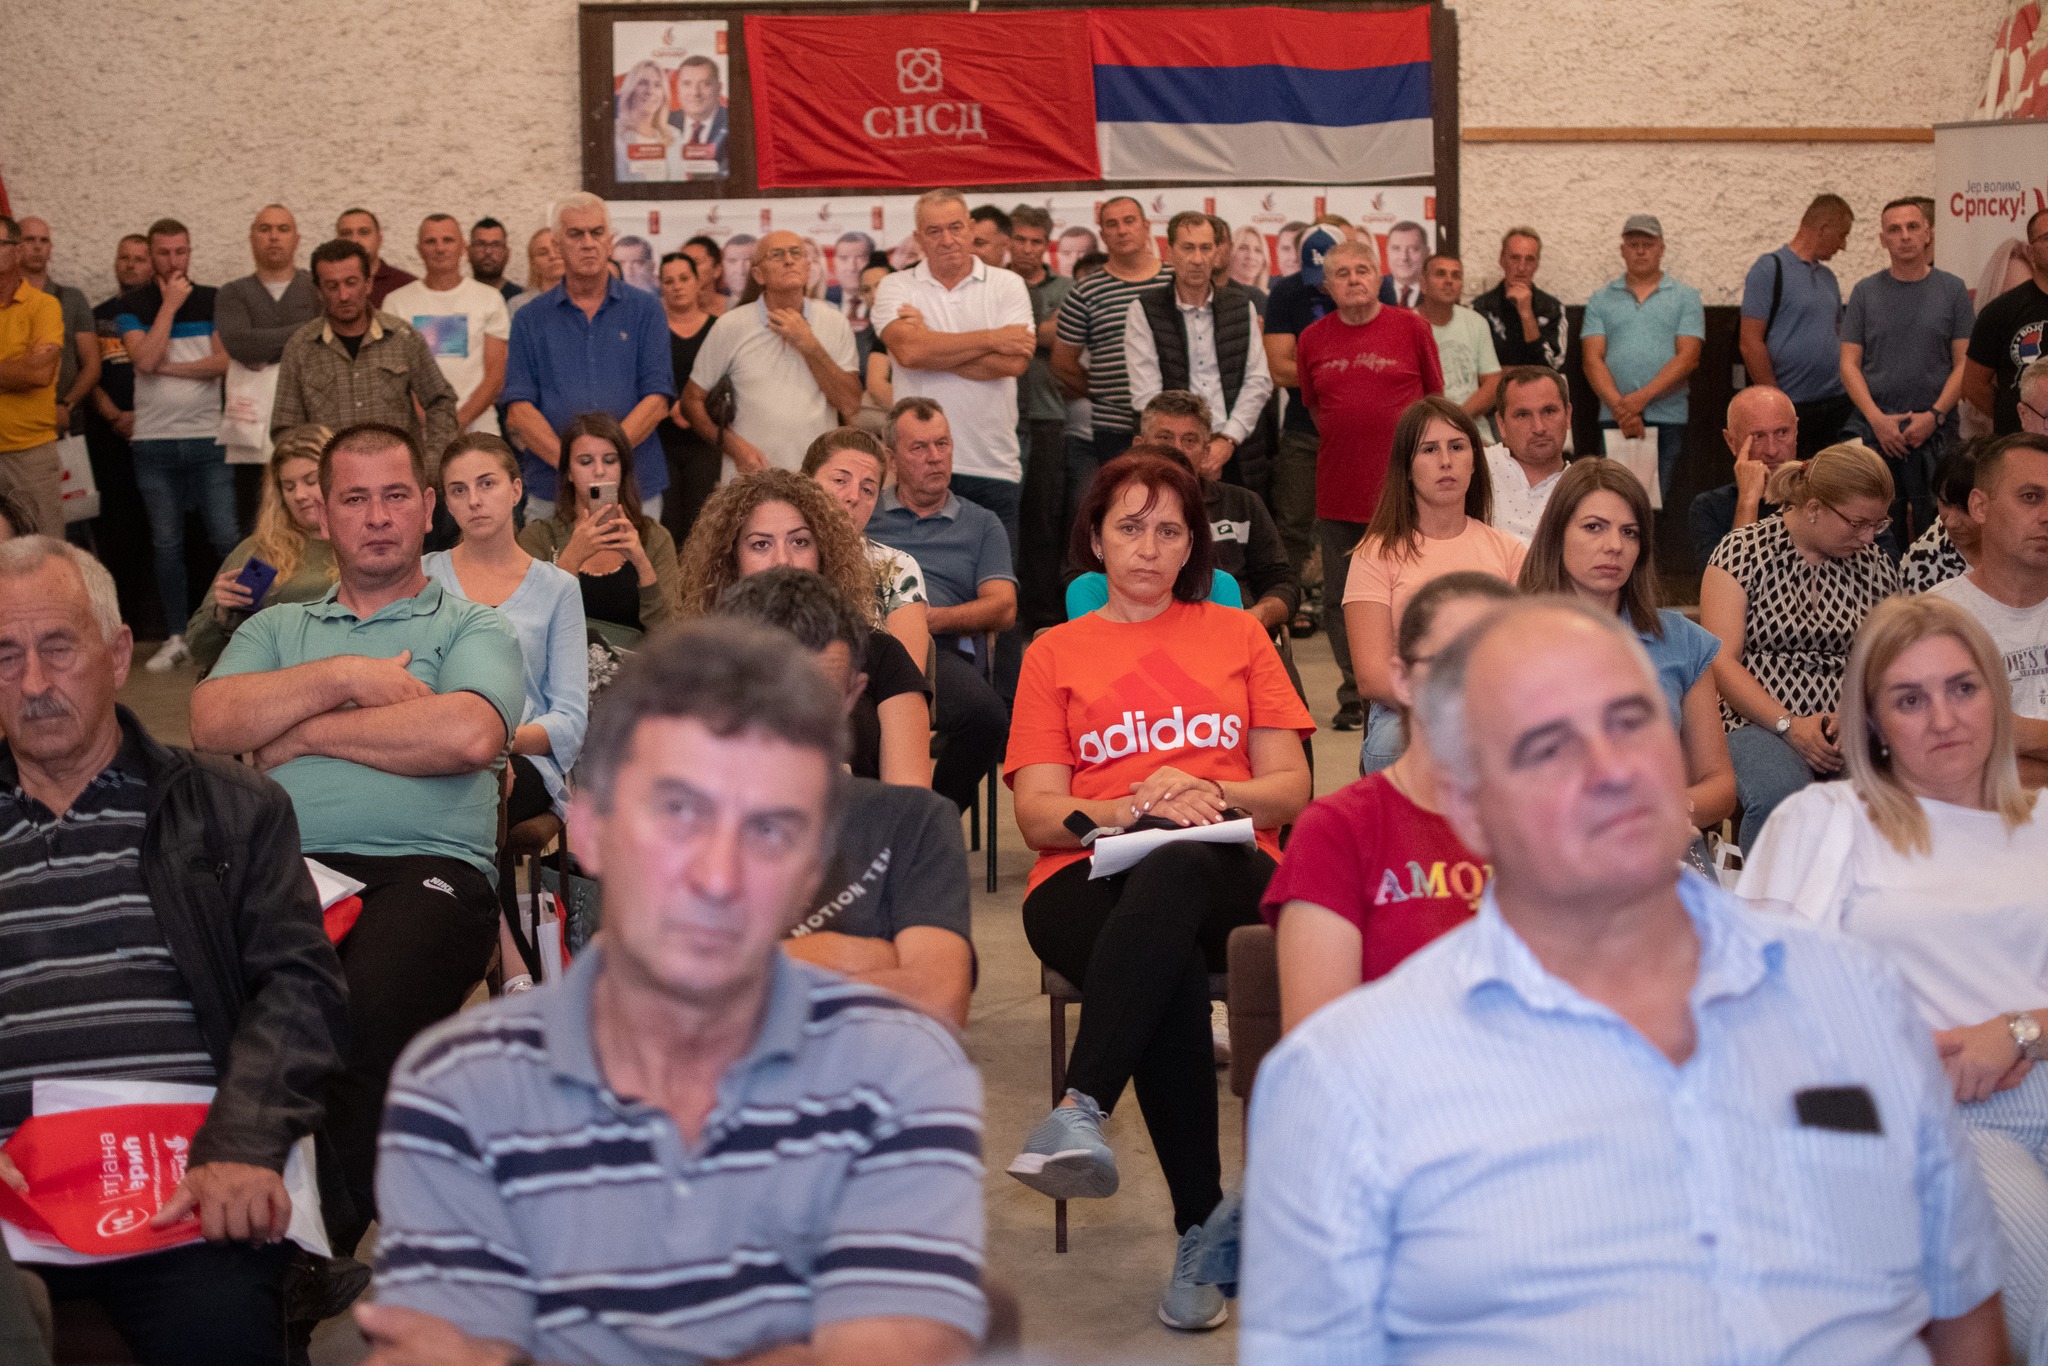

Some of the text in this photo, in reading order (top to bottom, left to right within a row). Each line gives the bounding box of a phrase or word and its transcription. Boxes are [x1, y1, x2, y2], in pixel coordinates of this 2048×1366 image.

[863, 102, 988, 139] СНСД
[1984, 181, 2021, 192] волимо
[1950, 191, 2026, 222] Српску!
[1079, 706, 1242, 764] adidas
[430, 876, 455, 893] NIKE
[1374, 861, 1494, 905] AMO
